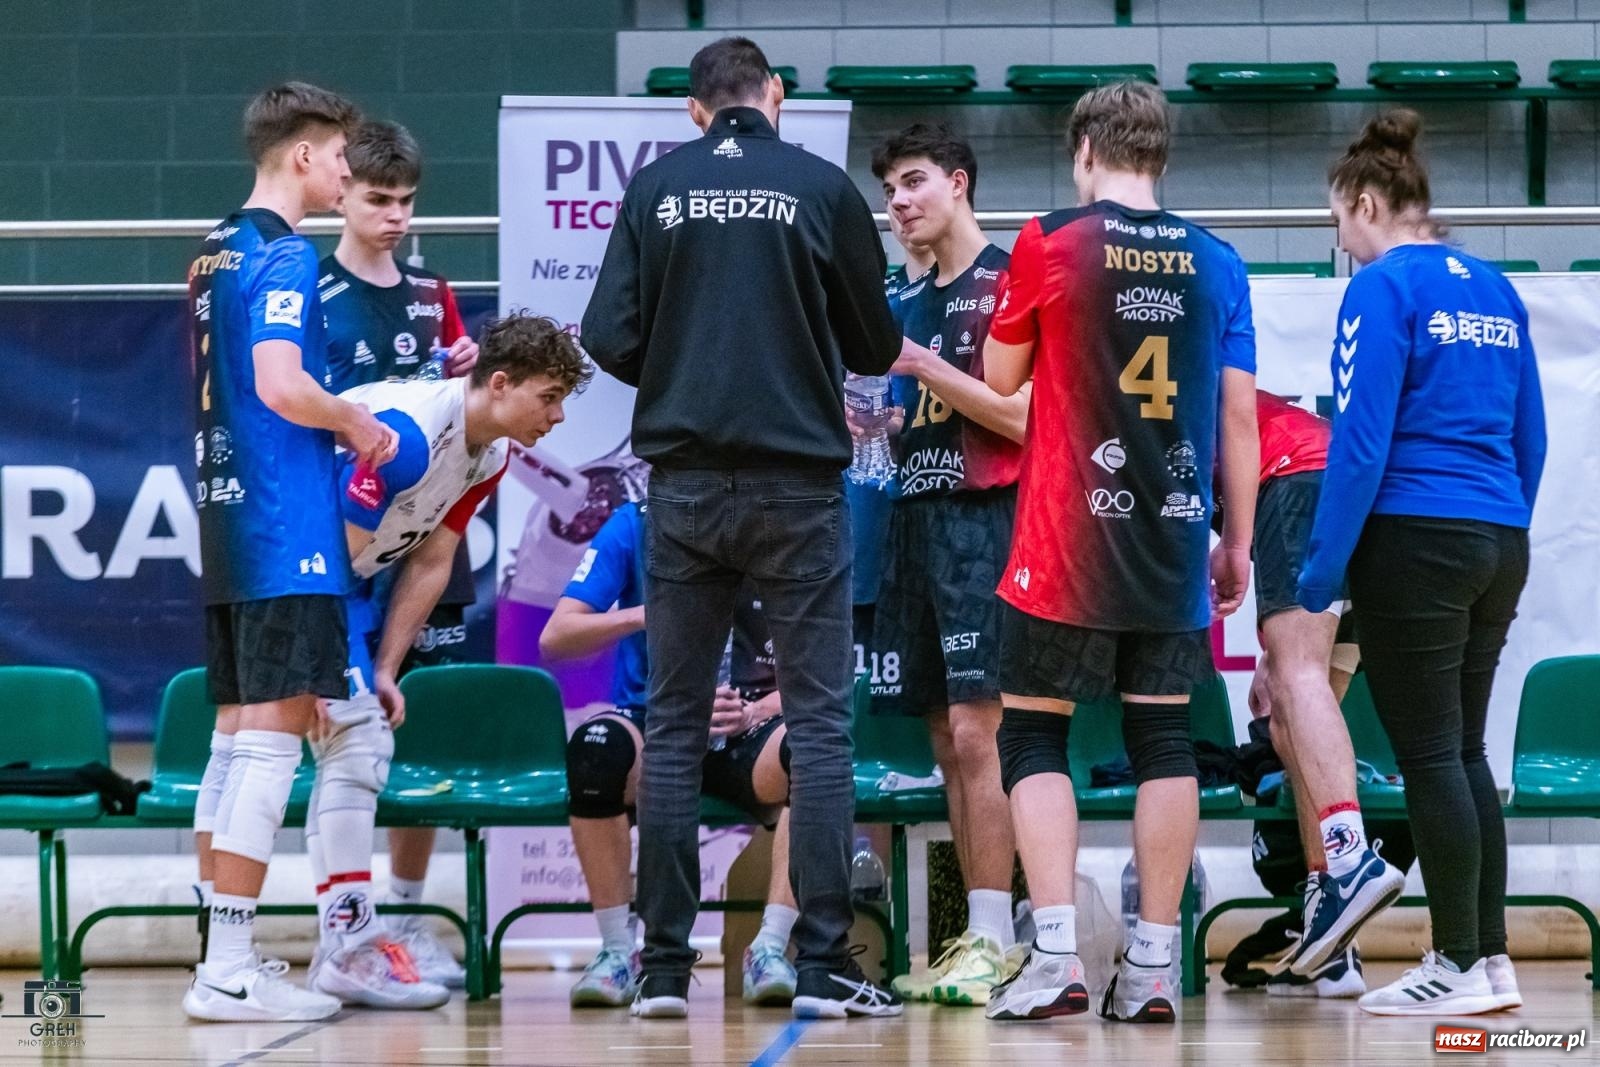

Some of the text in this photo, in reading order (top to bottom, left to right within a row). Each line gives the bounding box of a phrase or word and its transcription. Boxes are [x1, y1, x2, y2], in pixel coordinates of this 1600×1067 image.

[689, 189, 799, 205] MIEJSKI KLUB SPORTOWY
[689, 198, 796, 226] BĘDZIN
[1104, 219, 1187, 239] plus liga
[531, 259, 569, 280] Nie
[1104, 244, 1197, 275] NOSYK
[946, 296, 978, 318] plus
[1116, 286, 1184, 310] NOWAK
[1122, 308, 1177, 322] MOSTY
[1118, 335, 1178, 420] 4
[870, 651, 900, 684] 18
